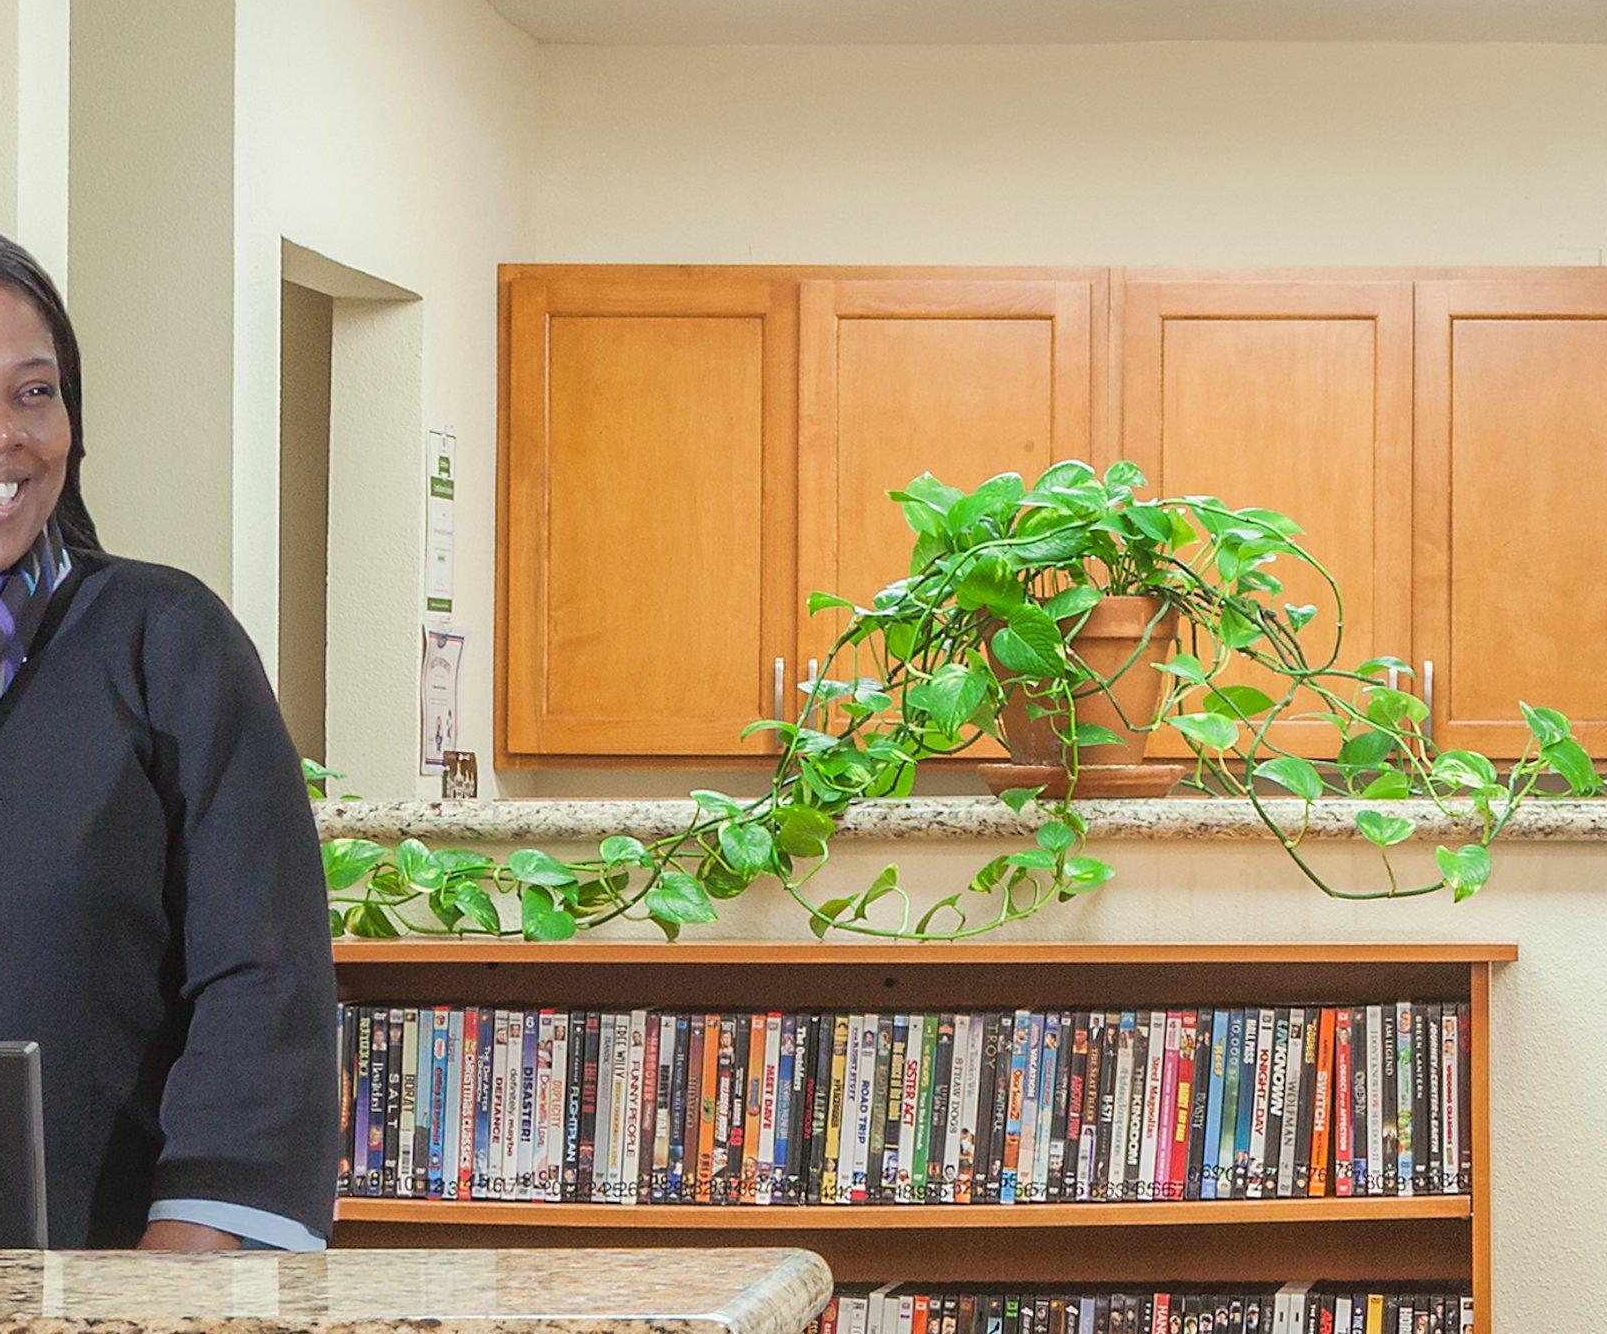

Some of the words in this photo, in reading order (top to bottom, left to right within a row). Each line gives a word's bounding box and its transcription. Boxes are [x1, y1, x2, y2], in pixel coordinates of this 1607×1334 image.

[616, 1025, 627, 1046] FREE
[796, 1027, 806, 1045] The
[985, 1024, 999, 1069] TROY
[1245, 1019, 1256, 1041] HALL
[1385, 1023, 1393, 1038] AM
[614, 1050, 626, 1079] WILLY
[794, 1047, 805, 1091] Outsiders
[1090, 1047, 1100, 1065] THE
[1151, 1056, 1161, 1081] Steel
[1243, 1041, 1255, 1064] PASS
[1270, 1019, 1288, 1116] UNKNOWN
[1385, 1039, 1393, 1076] LEGEND
[462, 1054, 473, 1116] CHRISTMAS
[630, 1060, 640, 1105] FUNNY
[765, 1064, 775, 1096] MEET
[905, 1059, 918, 1099] SISTER
[953, 1057, 963, 1098] STRAW
[1089, 1067, 1099, 1089] SEAT
[1258, 1049, 1269, 1098] KNIGHT
[1339, 1063, 1348, 1093] OBJECT
[387, 1073, 399, 1129] SALT
[404, 1074, 415, 1114] BORAT
[492, 1077, 503, 1144] DEFIANCE
[521, 1067, 533, 1142] DISASTER!
[551, 1079, 563, 1127] DUPLICITY
[860, 1079, 871, 1113] ROAD
[1086, 1090, 1097, 1121] FILLER
[1101, 1095, 1113, 1122] U-571
[1147, 1086, 1159, 1139] Magnolias
[1283, 1079, 1297, 1146] WOLFMAN
[1314, 1070, 1328, 1132] SWITCH
[567, 1087, 579, 1162] FLIGHTPLAN
[763, 1098, 774, 1129] DAVE
[858, 1117, 869, 1144] TRIP
[903, 1102, 915, 1127] ACT
[950, 1101, 961, 1134] DOGS
[1128, 1094, 1142, 1165] KINGDOM
[1255, 1108, 1267, 1136] DAY
[1339, 1107, 1348, 1151] AFFECTION
[627, 1108, 638, 1158] PEOPLE
[621, 1182, 637, 1197] 26
